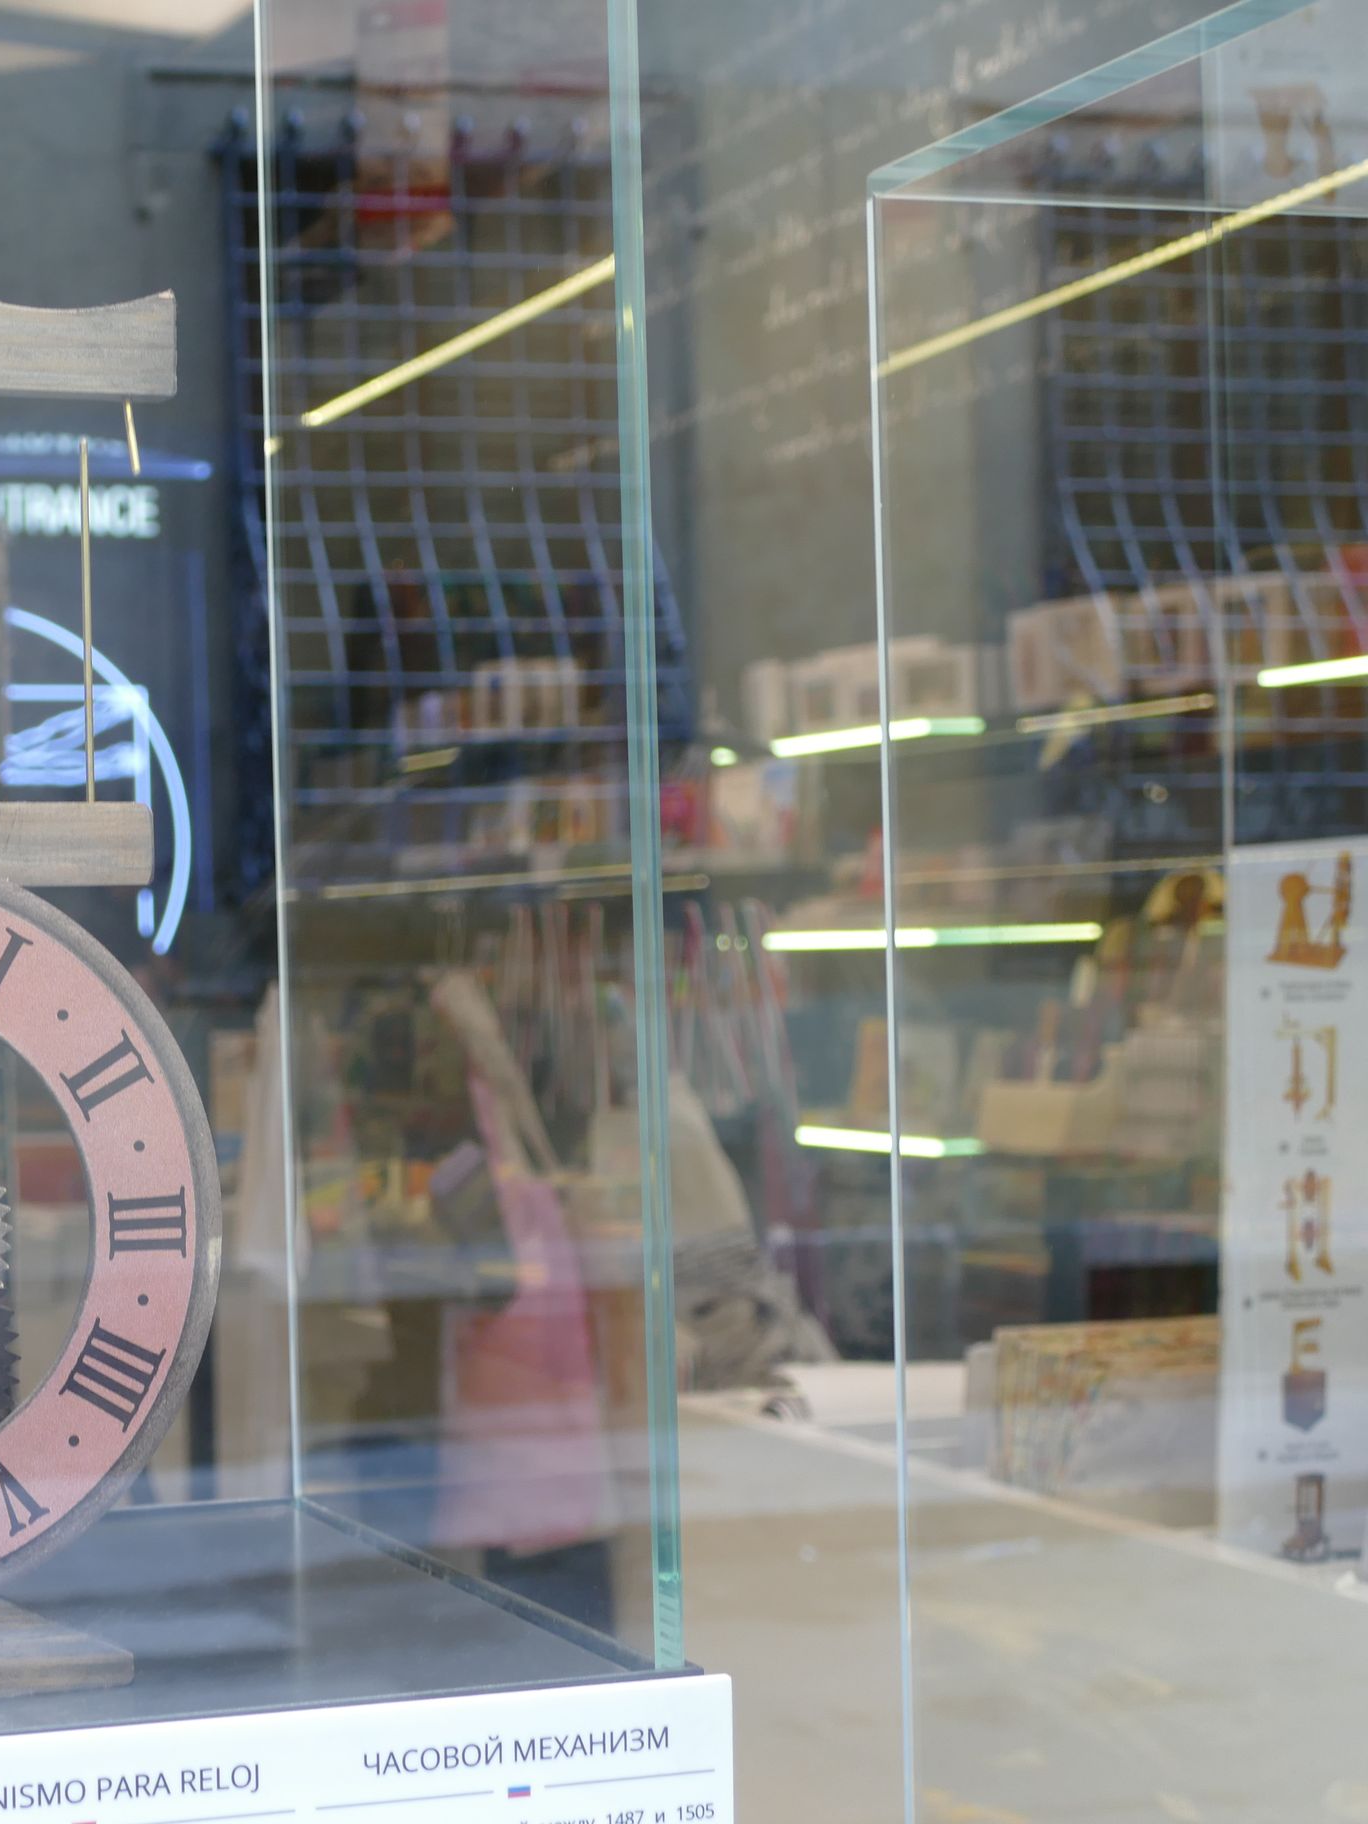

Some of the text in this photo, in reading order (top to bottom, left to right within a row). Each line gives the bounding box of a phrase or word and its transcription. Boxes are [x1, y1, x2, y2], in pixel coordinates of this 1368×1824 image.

[59, 1029, 155, 1122] II
[107, 1185, 187, 1260] III
[59, 1317, 167, 1433] IIII
[363, 1726, 670, 1776] ЧАСОВОЙ МЕХАНИЗМ
[97, 1772, 172, 1802] PARA
[180, 1763, 261, 1794] RELOJ
[677, 1802, 716, 1822] 1505
